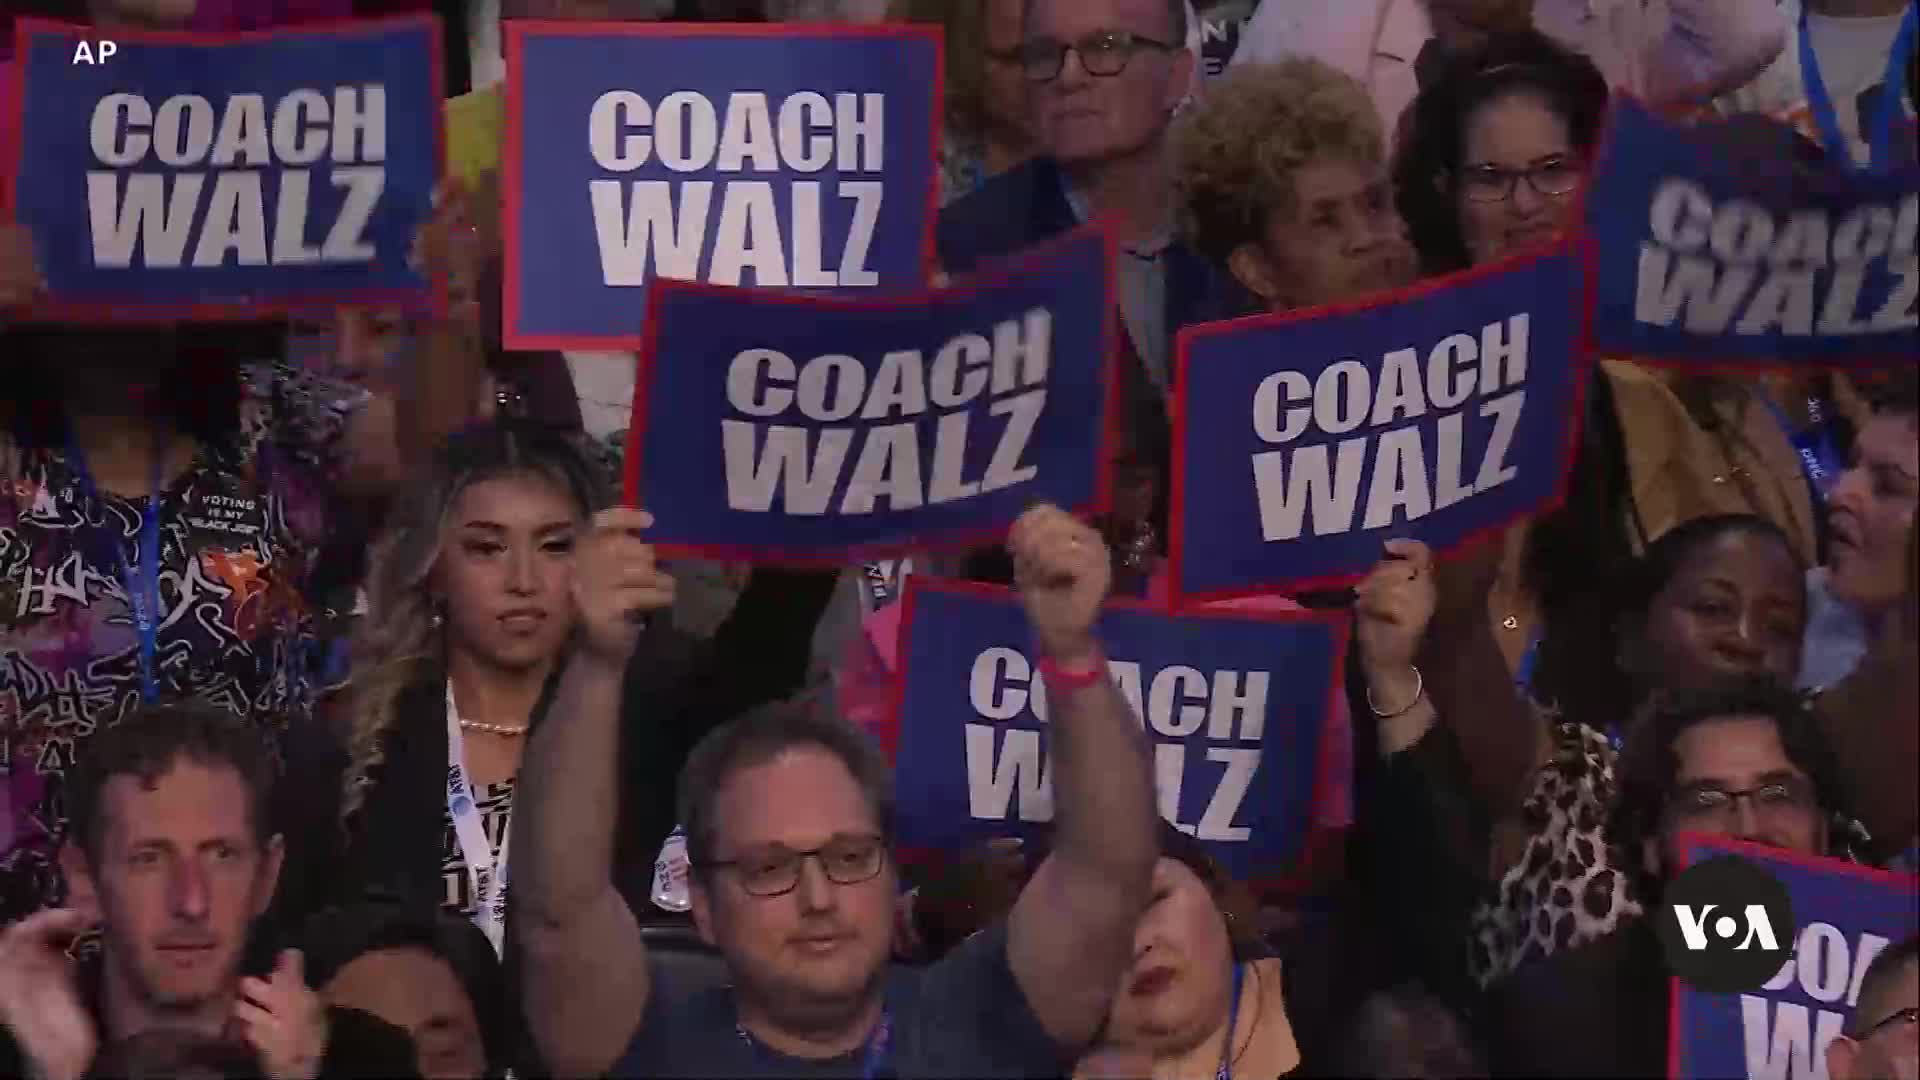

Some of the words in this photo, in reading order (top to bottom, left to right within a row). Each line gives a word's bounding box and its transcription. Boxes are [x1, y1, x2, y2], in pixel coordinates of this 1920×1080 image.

[90, 84, 386, 167] COACH
[588, 90, 884, 172] COACH
[87, 168, 386, 268] WALZ
[590, 180, 883, 287] WALZ
[725, 306, 1053, 422] COACH
[1252, 313, 1530, 443] COACH
[202, 495, 257, 511] VOTING
[721, 389, 1048, 515] WALZ
[1251, 390, 1526, 542] WALZ
[223, 509, 244, 520] MY
[965, 723, 1262, 841] WLZ
